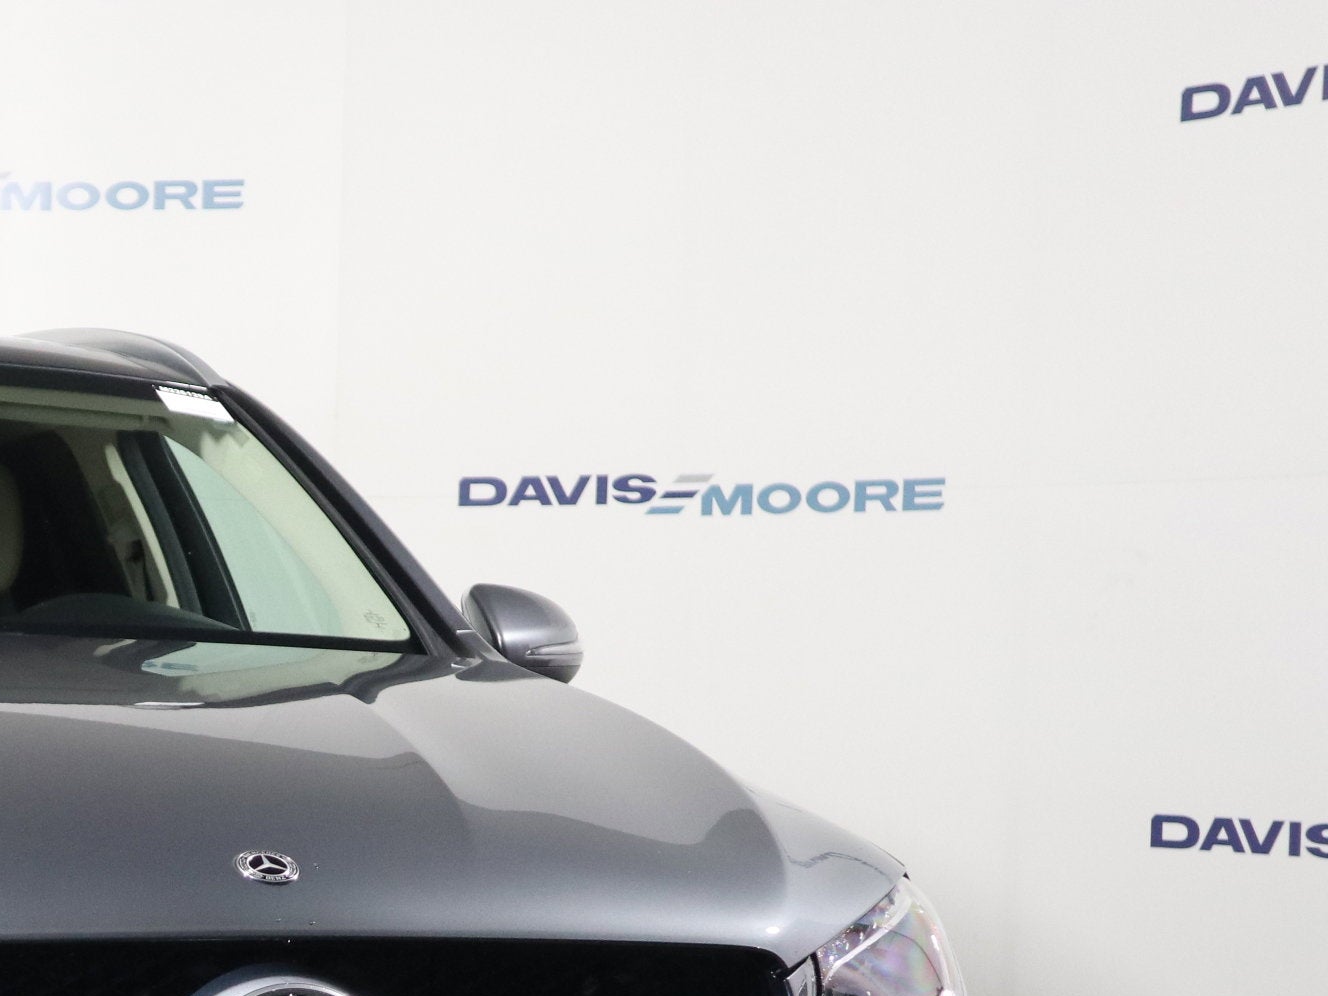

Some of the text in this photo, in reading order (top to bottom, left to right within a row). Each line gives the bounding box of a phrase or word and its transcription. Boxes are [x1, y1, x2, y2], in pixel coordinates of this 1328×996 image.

[0, 178, 246, 212] MOORE
[457, 473, 946, 516] DAVIS MOORE
